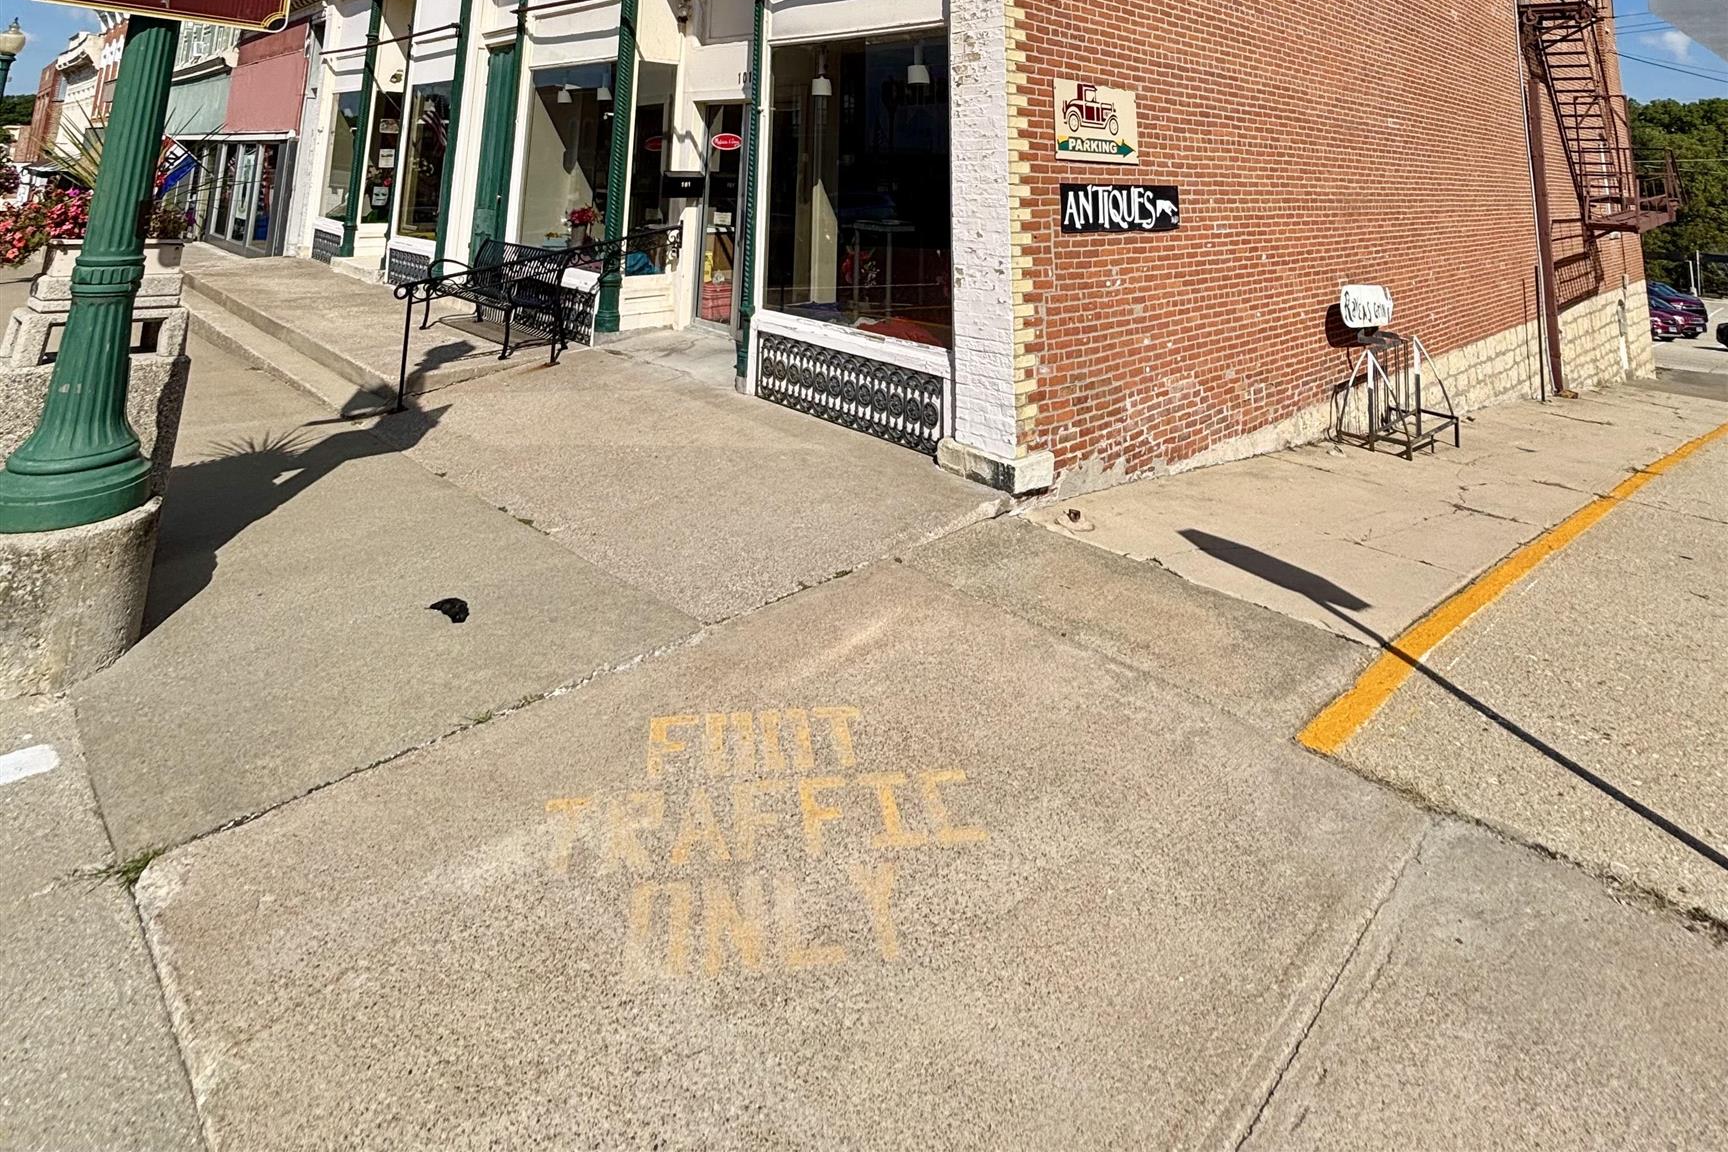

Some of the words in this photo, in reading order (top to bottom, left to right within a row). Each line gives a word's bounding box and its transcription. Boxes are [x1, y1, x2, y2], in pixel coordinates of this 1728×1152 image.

[738, 71, 752, 85] 101
[1068, 138, 1118, 154] PARKING
[1063, 184, 1156, 229] ANTIQUES
[544, 768, 989, 875] TRAFFIC
